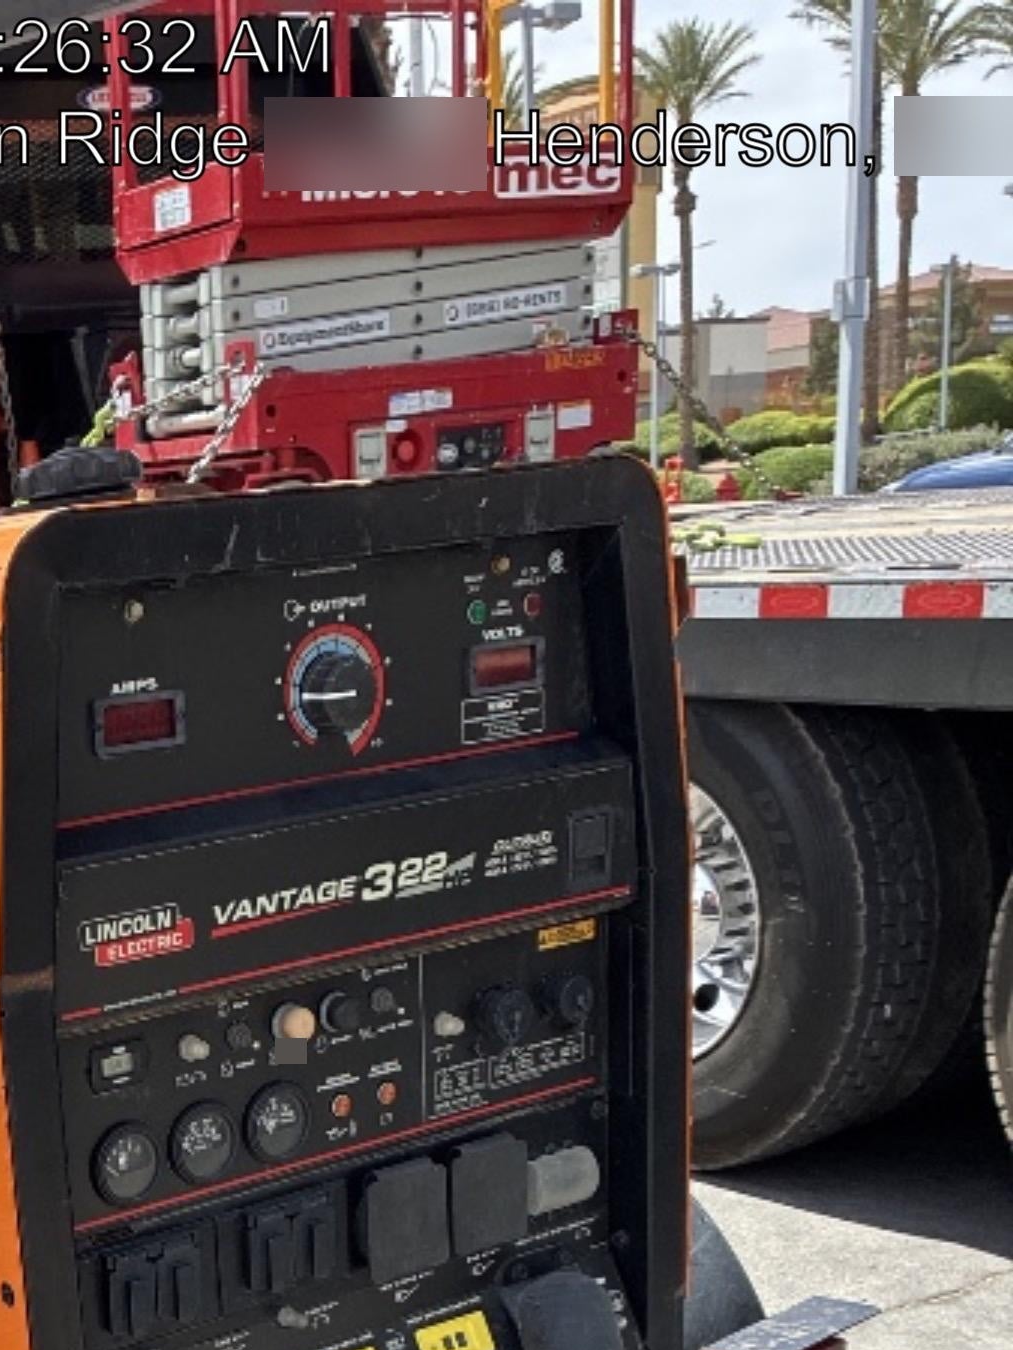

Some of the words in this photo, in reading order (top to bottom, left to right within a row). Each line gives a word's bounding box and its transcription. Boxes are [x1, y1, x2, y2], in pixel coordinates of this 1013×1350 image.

[211, 875, 356, 926] VANTAGE
[361, 850, 448, 902] 322
[85, 910, 171, 946] LINCOLN
[107, 932, 184, 961] ELECTRIC
